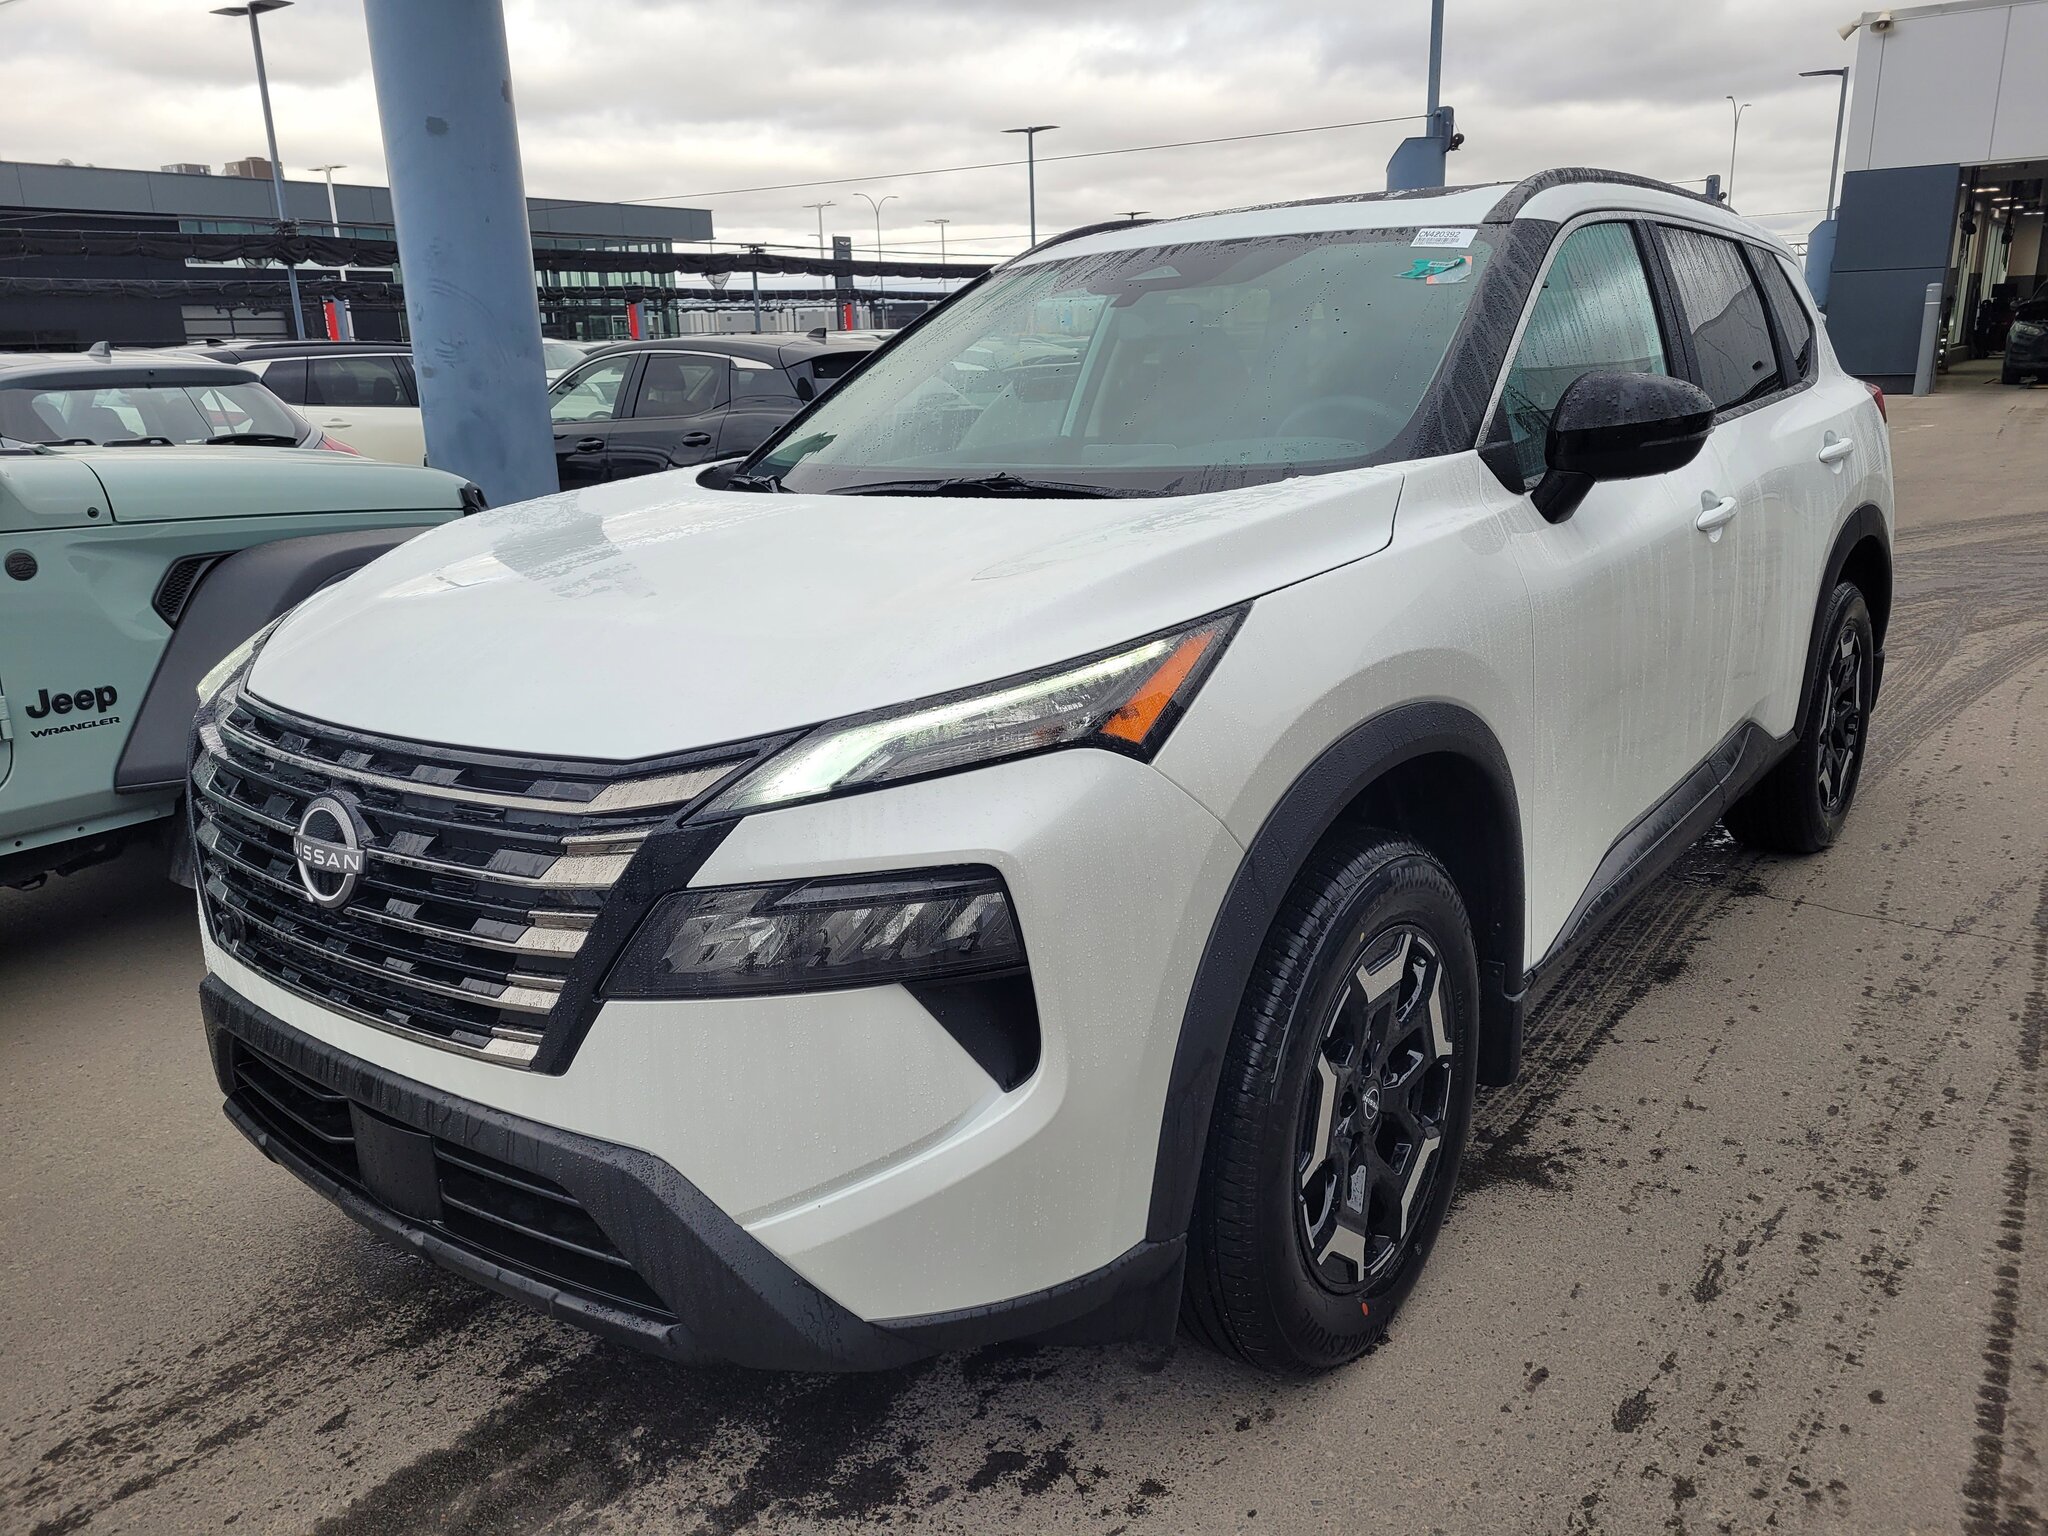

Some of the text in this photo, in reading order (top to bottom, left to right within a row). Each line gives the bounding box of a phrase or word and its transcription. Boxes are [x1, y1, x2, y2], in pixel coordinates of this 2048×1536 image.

[1419, 230, 1461, 238] CN420392
[25, 684, 118, 719] Jeep
[30, 716, 121, 738] WRANGLER
[293, 836, 360, 871] NISSAN
